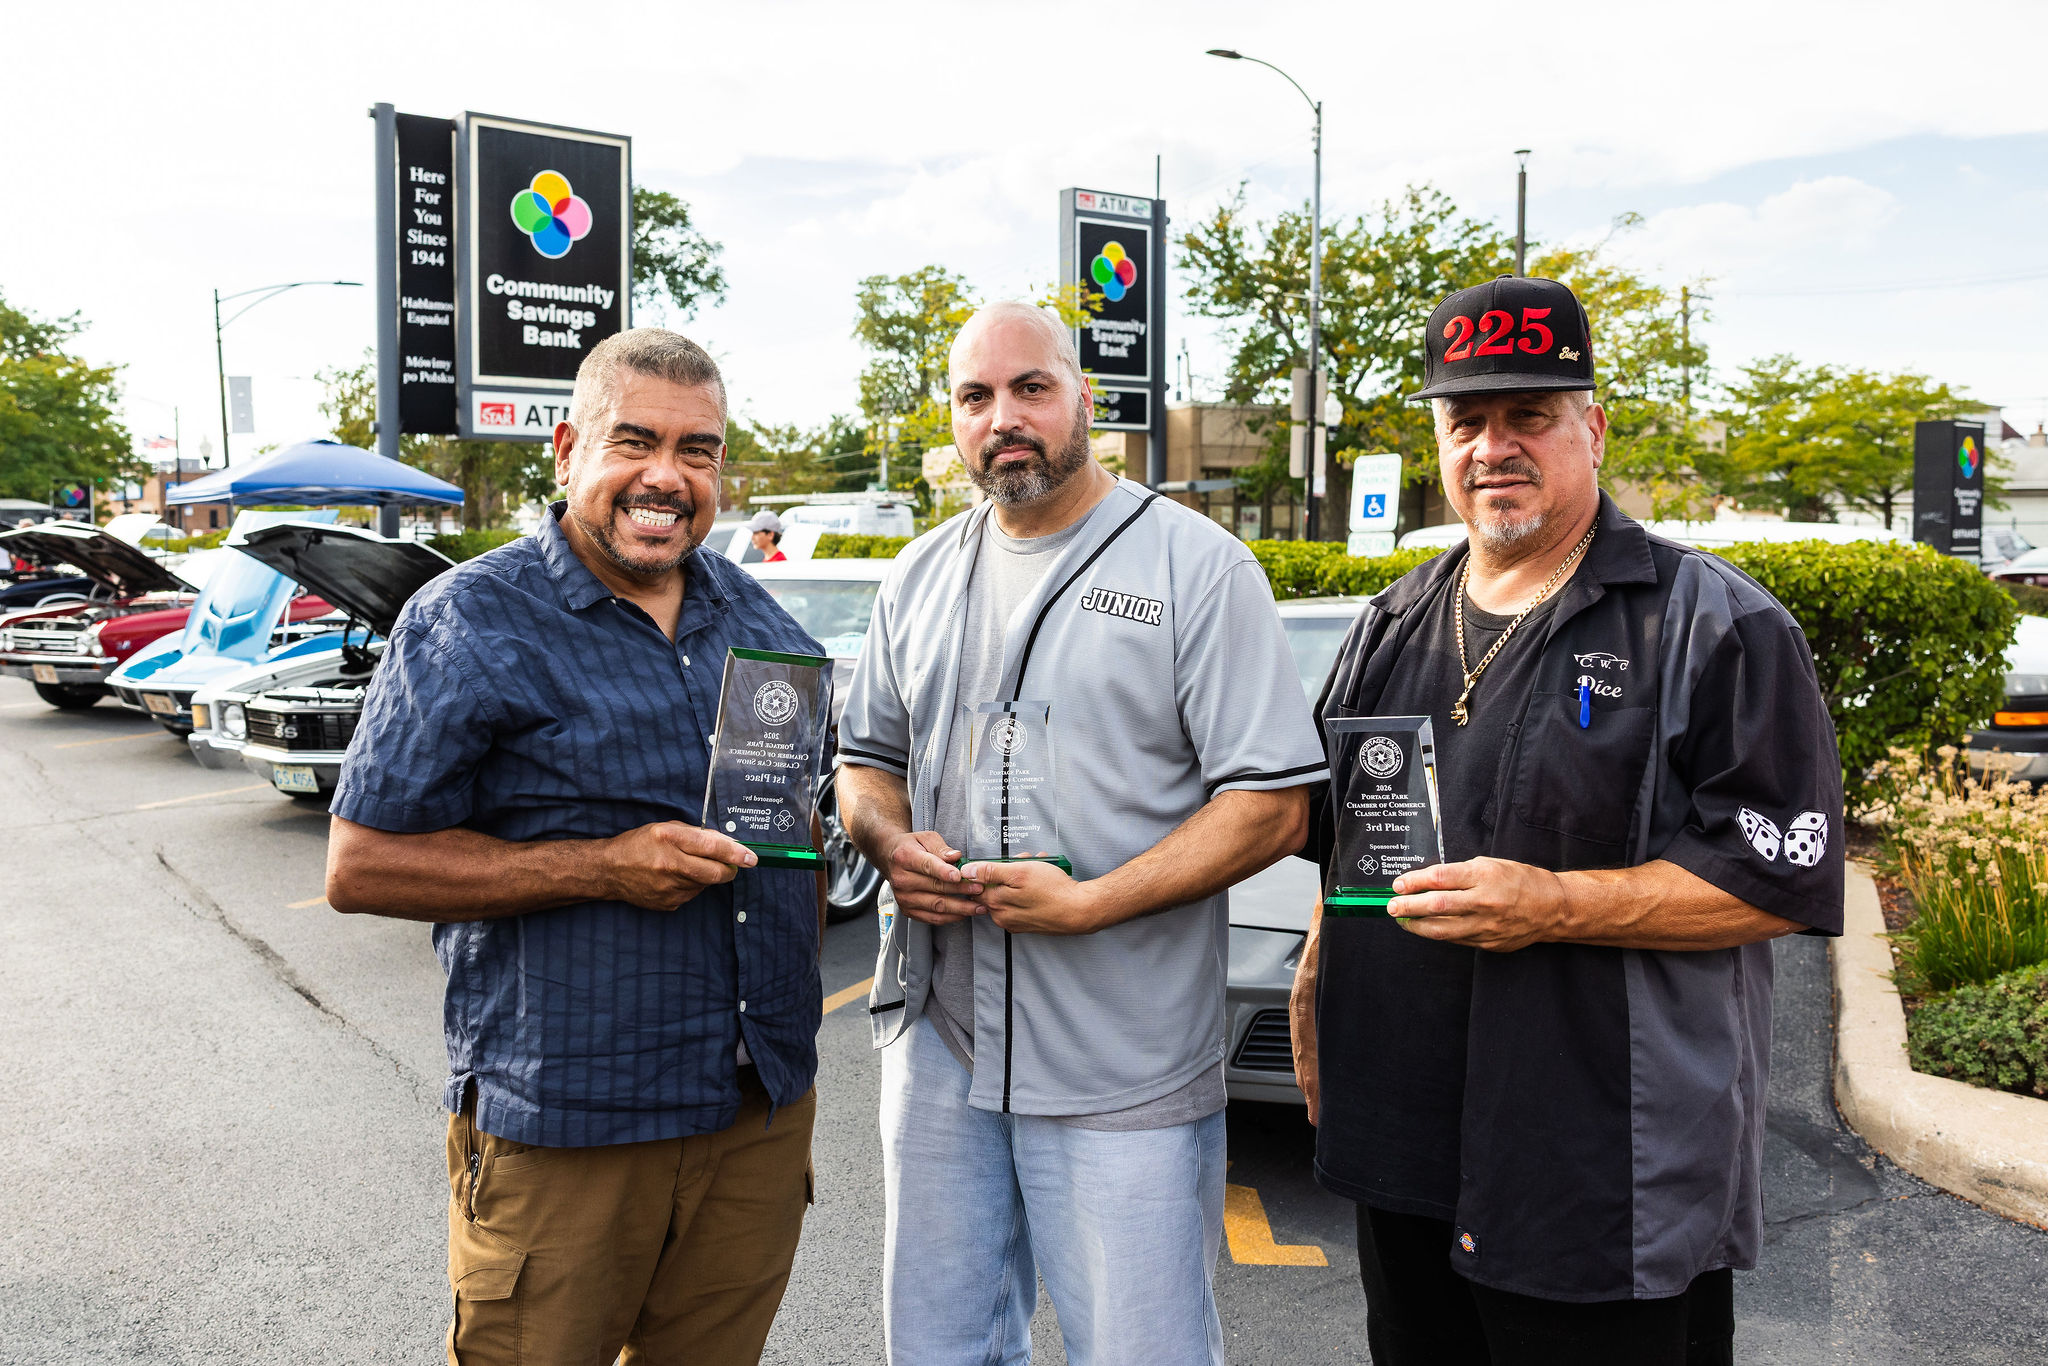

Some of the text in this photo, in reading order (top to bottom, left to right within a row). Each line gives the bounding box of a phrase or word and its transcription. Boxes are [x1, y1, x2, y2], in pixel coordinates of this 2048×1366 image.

[409, 166, 446, 186] Here
[414, 188, 441, 205] For
[1100, 197, 1128, 212] ATM
[413, 208, 442, 226] You
[406, 228, 448, 247] Since
[410, 250, 445, 267] 1944
[486, 273, 614, 309] Community
[507, 300, 596, 330] Savings
[523, 325, 581, 349] Bank
[1442, 307, 1554, 364] 225
[403, 372, 418, 384] po
[1082, 588, 1164, 626] JUNIOR
[1366, 823, 1410, 832] 3rd Place
[1381, 855, 1425, 863] Community
